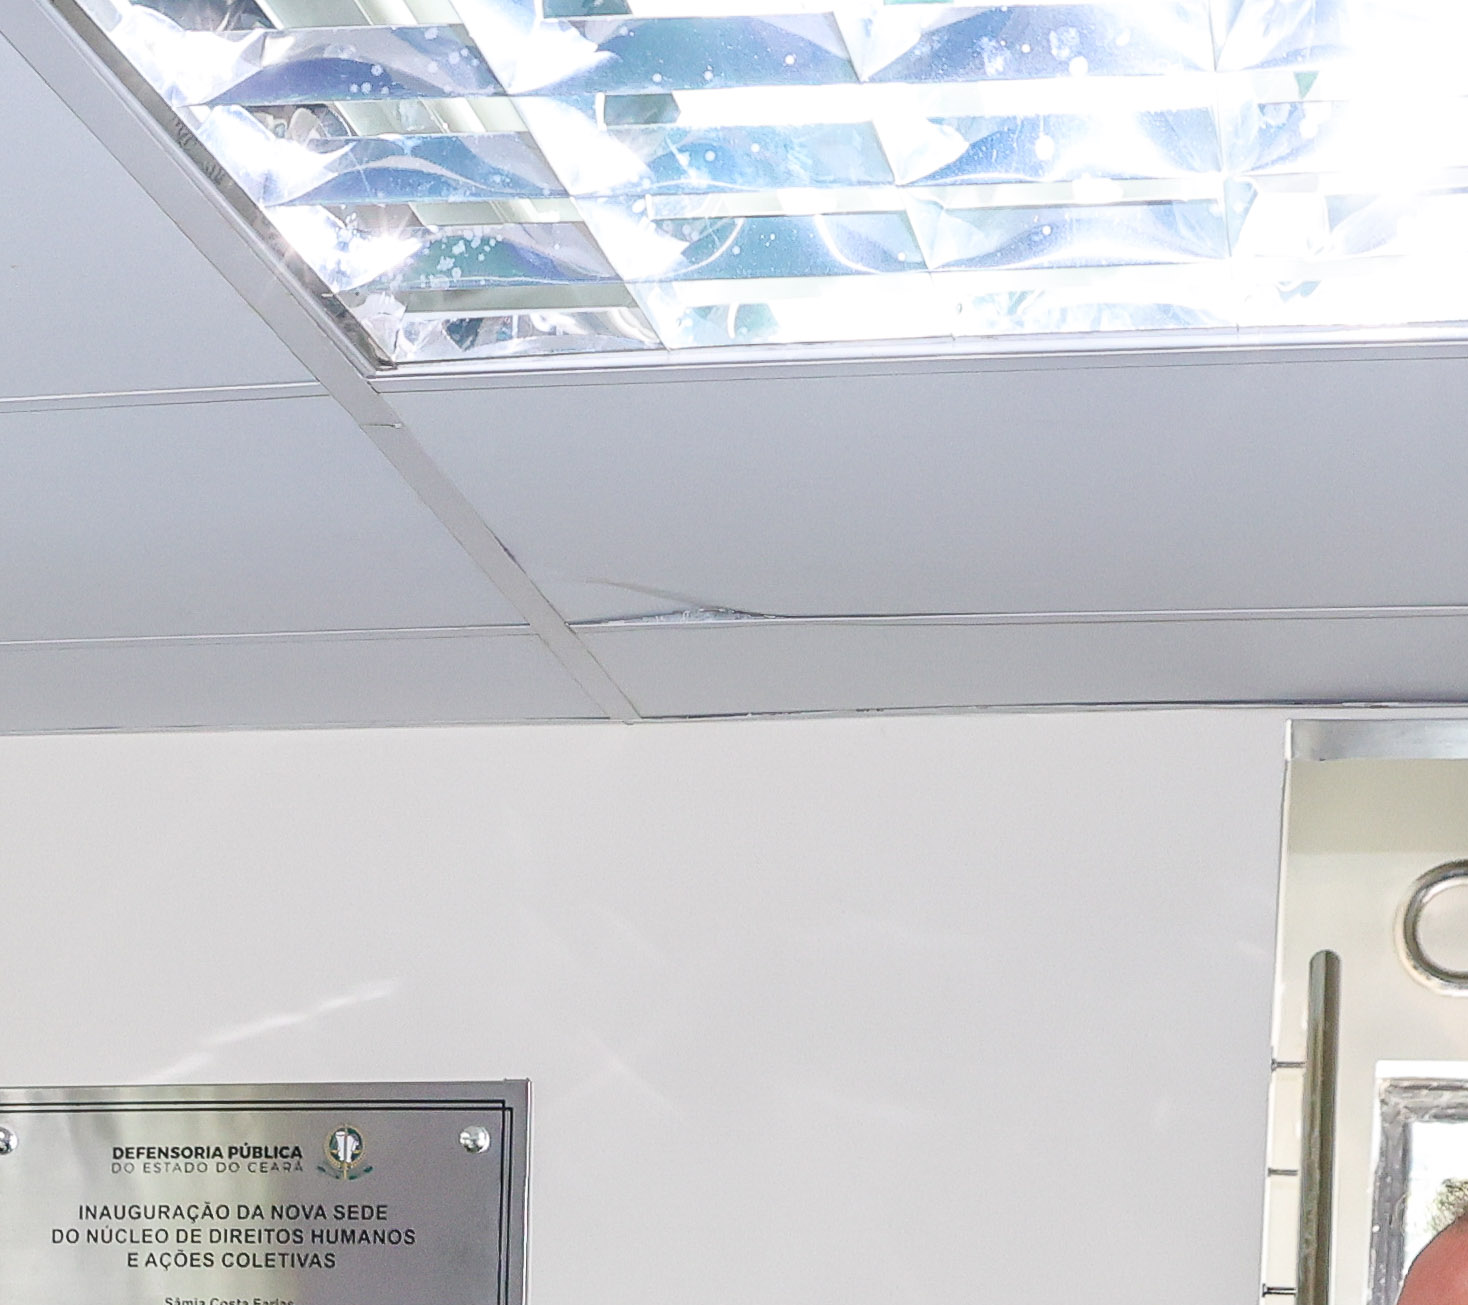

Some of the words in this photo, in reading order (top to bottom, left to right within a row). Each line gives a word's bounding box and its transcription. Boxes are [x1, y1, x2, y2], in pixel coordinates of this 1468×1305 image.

[113, 1146, 223, 1160] DEFENSORIA
[228, 1142, 302, 1159] PÚBLICA
[111, 1162, 134, 1174] DO
[143, 1162, 208, 1173] ESTADO
[216, 1162, 240, 1173] DO
[78, 1202, 229, 1224] INAUGURAÇÃO
[237, 1205, 264, 1220] DA
[271, 1205, 326, 1221] NOVA
[334, 1205, 388, 1221] SEDE
[52, 1229, 79, 1244] DO
[86, 1225, 168, 1244] NÚCLEO
[176, 1229, 201, 1244] DE
[210, 1229, 304, 1245] DIREITOS
[311, 1229, 415, 1245] HUMANOS
[128, 1253, 138, 1267] E
[145, 1249, 214, 1271] AÇÕES
[222, 1253, 336, 1268] COLETIVAS
